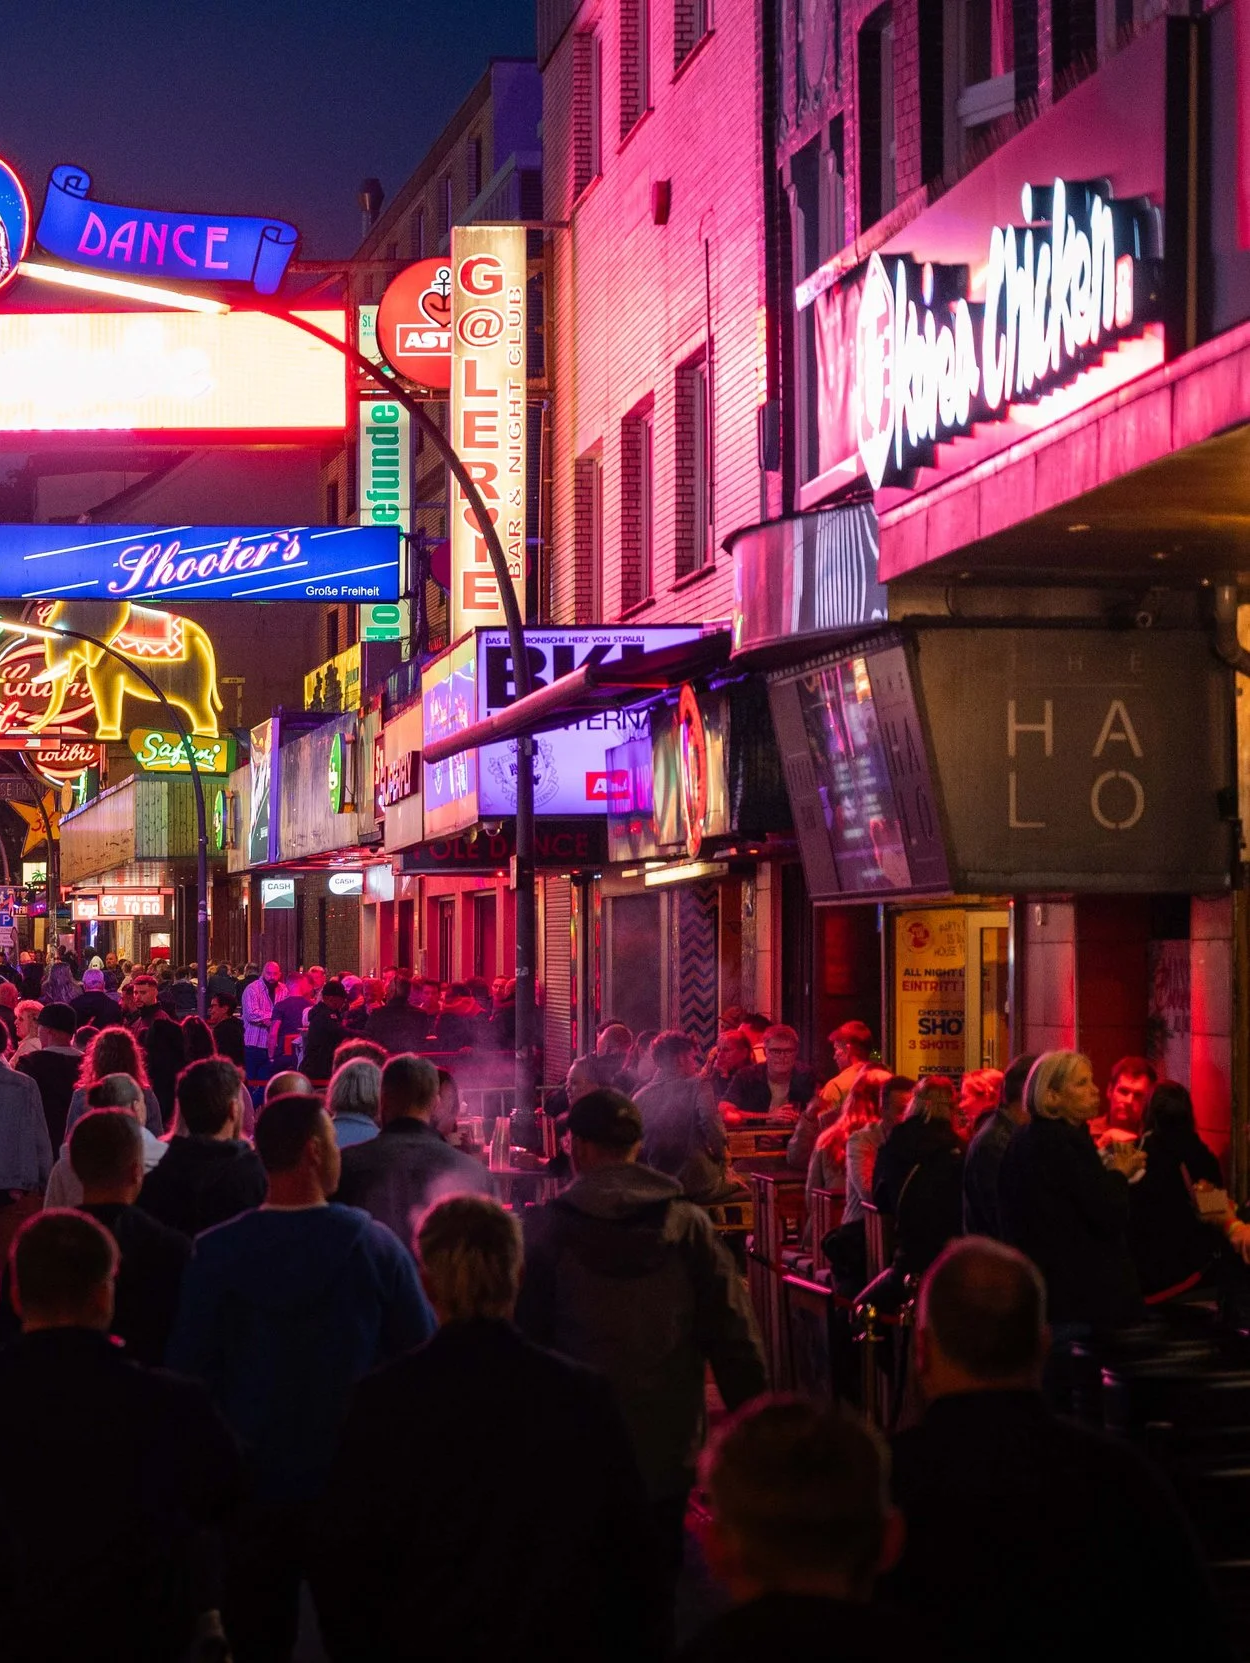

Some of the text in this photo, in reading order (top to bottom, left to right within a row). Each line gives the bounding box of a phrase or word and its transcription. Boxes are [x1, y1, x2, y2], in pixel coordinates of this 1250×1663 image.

[77, 210, 230, 271] DANCE
[508, 287, 523, 367] CLUB
[404, 331, 451, 348] AST
[508, 379, 523, 474] NIGHT
[508, 520, 523, 579] BAR
[107, 531, 302, 593] Shooter's
[305, 585, 380, 597] Große Freiheit
[485, 636, 501, 645] DAS
[568, 636, 589, 644] HERZ
[592, 636, 611, 644] VON
[136, 733, 221, 768] Safri
[412, 833, 589, 861] OLE DNCE
[124, 902, 140, 915] TO
[143, 902, 160, 915] GO
[2, 915, 11, 925] P
[903, 968, 921, 977] ALL
[924, 968, 957, 977] NIGHT
[902, 980, 959, 992] EINTRITT
[918, 1017, 965, 1036] SHO
[908, 1039, 957, 1050] 3 SHOTS
